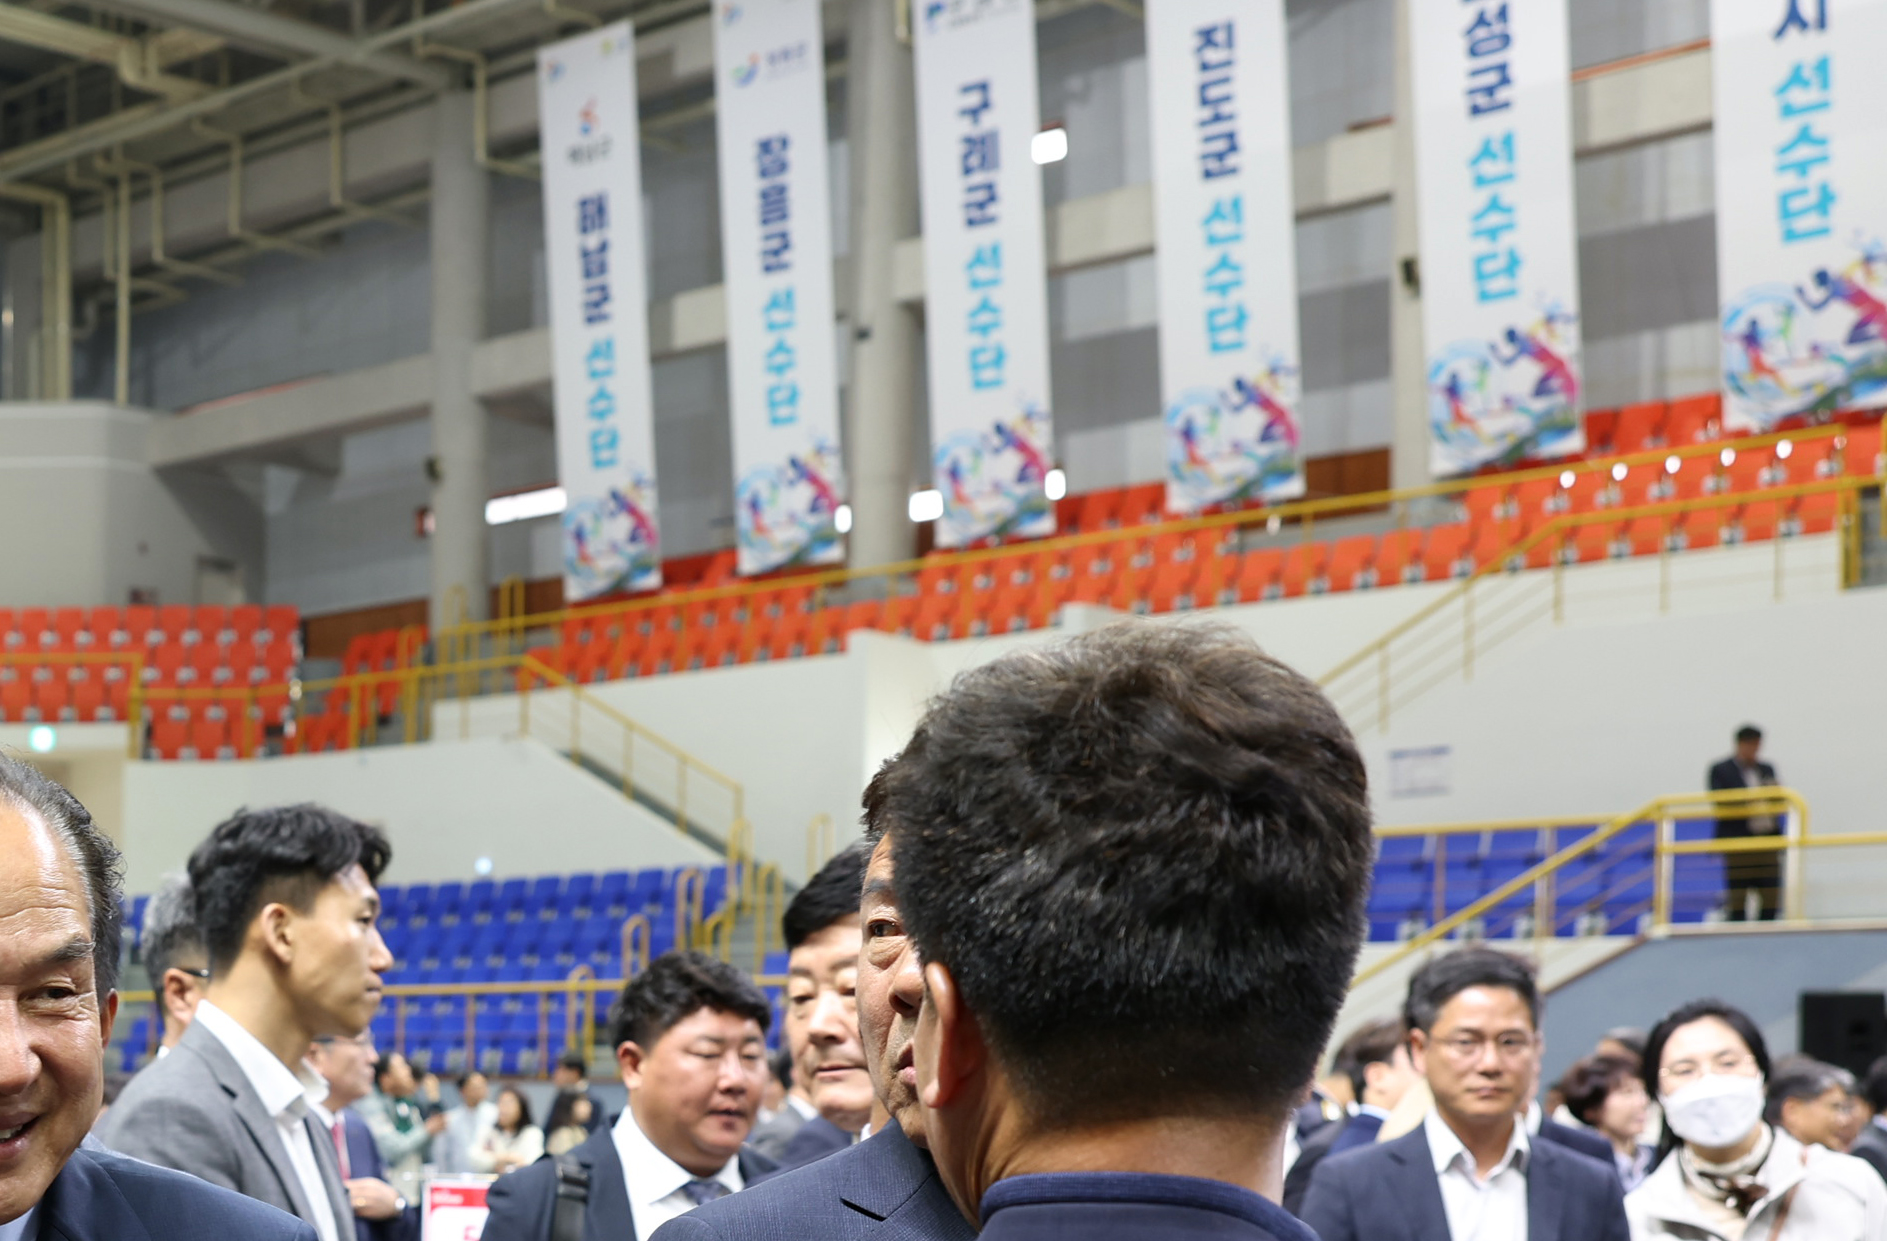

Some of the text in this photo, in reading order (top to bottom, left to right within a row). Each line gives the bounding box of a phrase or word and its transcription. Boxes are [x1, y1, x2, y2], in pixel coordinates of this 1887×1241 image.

[960, 79, 1008, 391] 구례군 선수단
[1197, 22, 1250, 355] 진도군 선수단
[1465, 0, 1524, 304] 성군 선수단
[1773, 54, 1838, 245] 선수단
[585, 337, 620, 470] 선수단
[763, 286, 801, 427] 선수단
